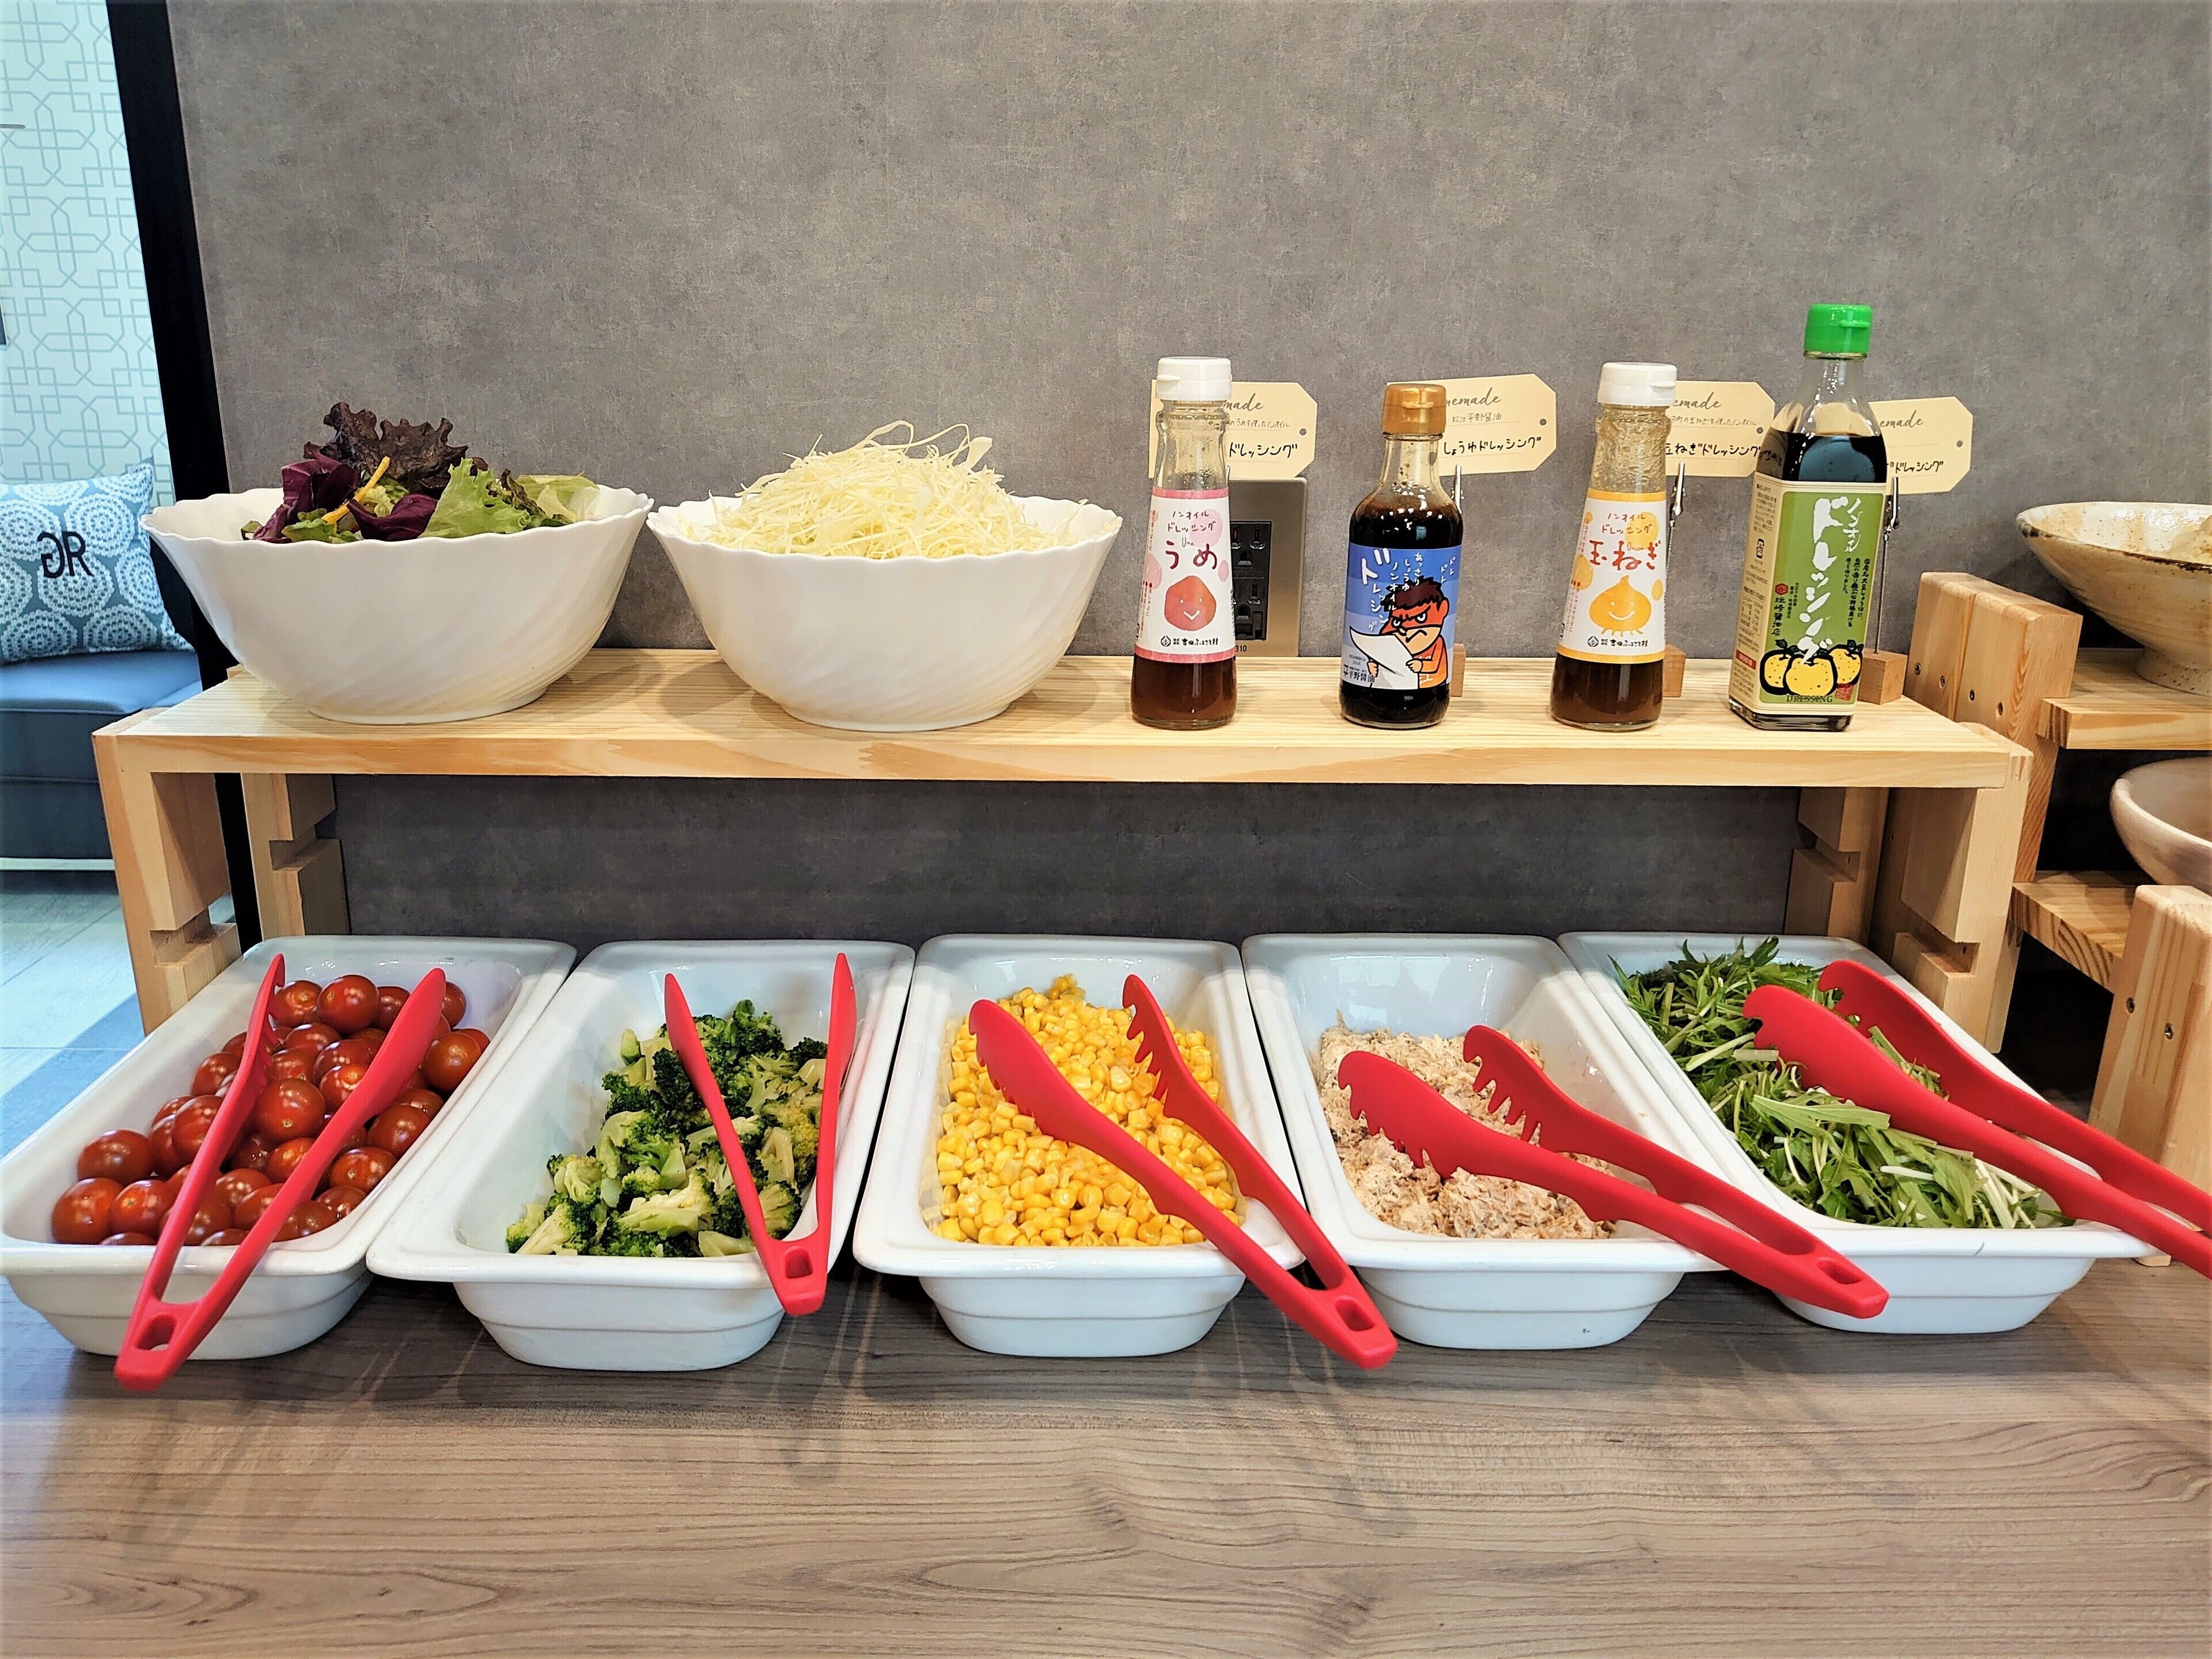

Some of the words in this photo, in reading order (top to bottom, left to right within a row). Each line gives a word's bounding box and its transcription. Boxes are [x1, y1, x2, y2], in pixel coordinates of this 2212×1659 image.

[1229, 442, 1298, 459] ドレッシング
[1444, 436, 1541, 456] しょうゆドレッシング
[1172, 510, 1210, 520] ノンオイル
[1607, 513, 1646, 522] ノンオイル
[1167, 520, 1216, 532] ドレッシング
[1601, 524, 1653, 535] ドレッシング
[1165, 540, 1218, 570] うめ
[1589, 540, 1661, 571] 玉ねぎ
[1402, 558, 1412, 592] しょうゆ
[1414, 552, 1423, 586] あっさり
[1388, 561, 1400, 611] ノンオイル
[1786, 695, 1833, 703] DRESSING
